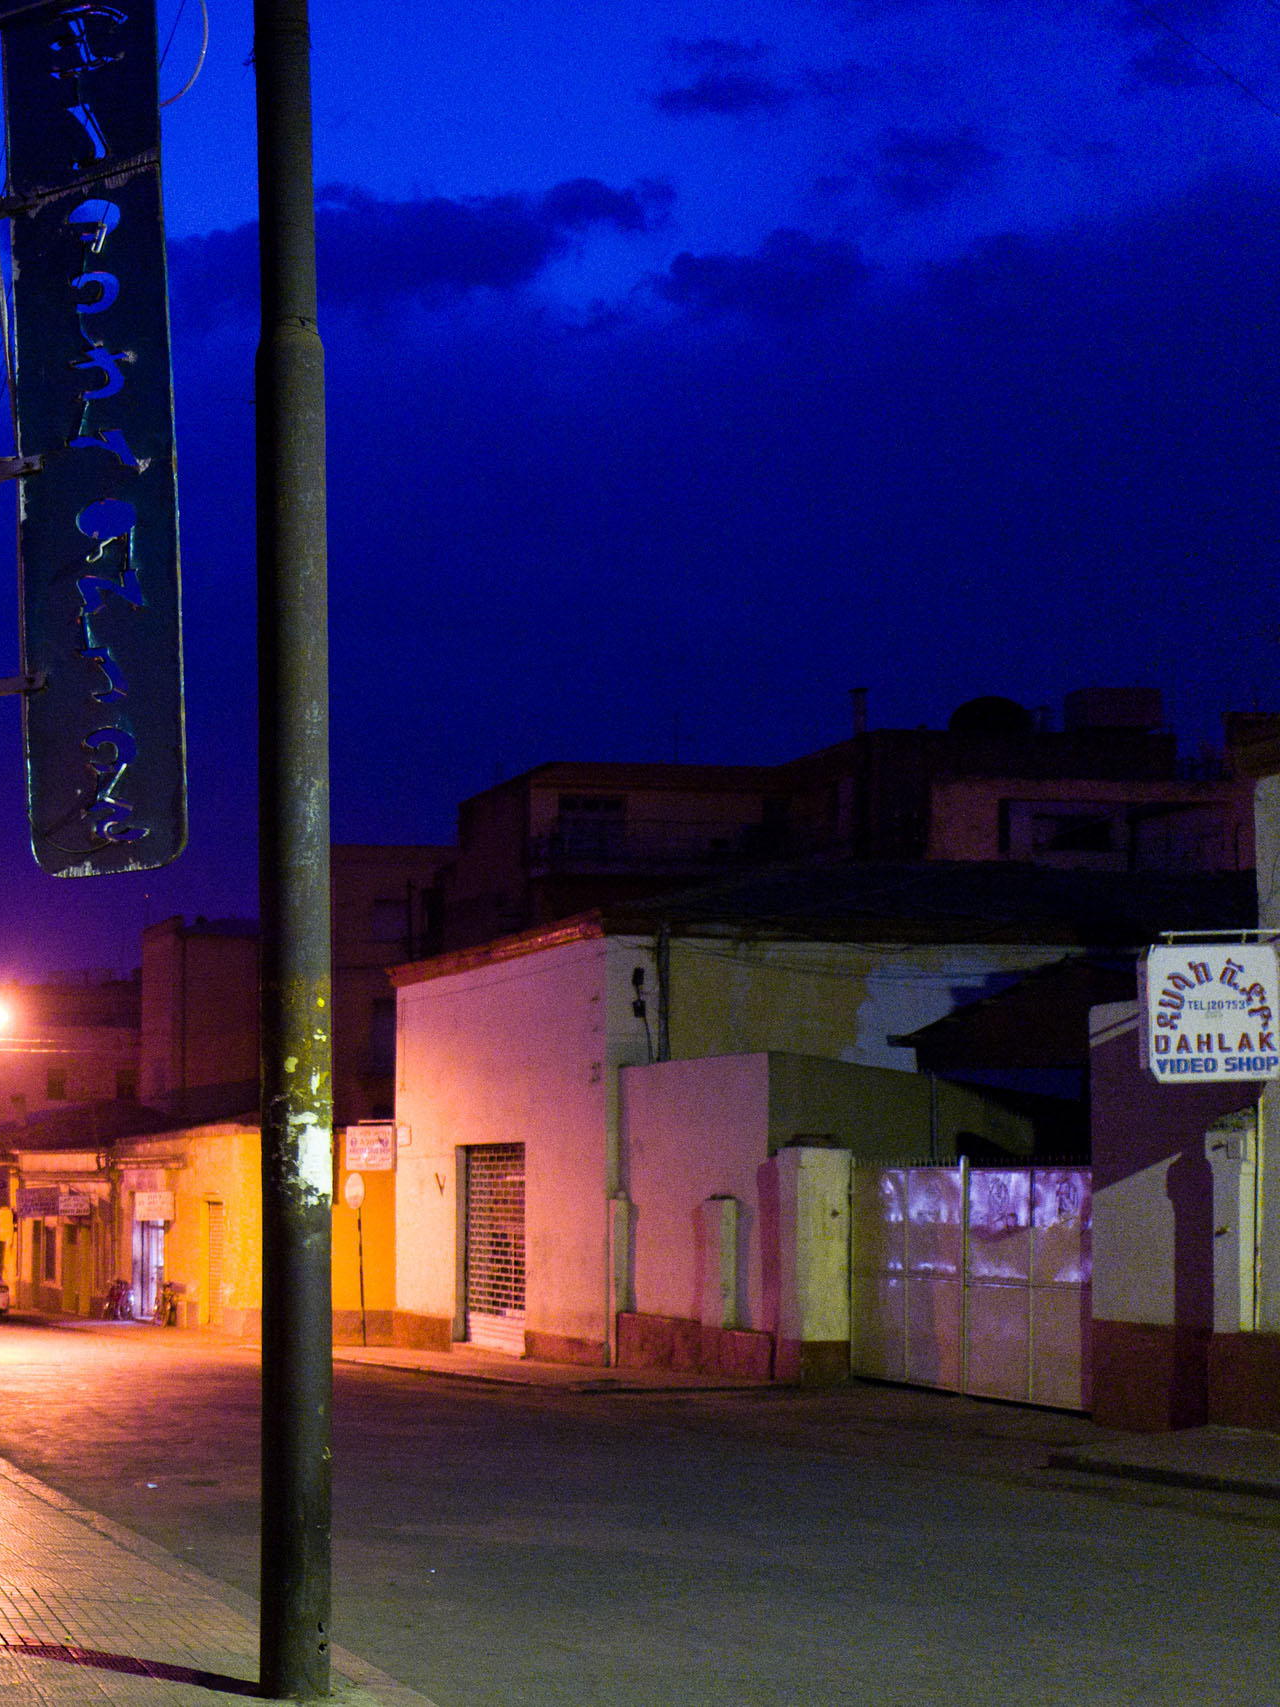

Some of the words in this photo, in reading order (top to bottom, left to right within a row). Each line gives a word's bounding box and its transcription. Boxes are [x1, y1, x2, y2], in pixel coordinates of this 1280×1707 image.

[1187, 1000, 1204, 1010] TEL
[1154, 1032, 1277, 1054] DAHLAK
[1156, 1058, 1218, 1074] VIDEO
[1224, 1056, 1279, 1072] SHOP
